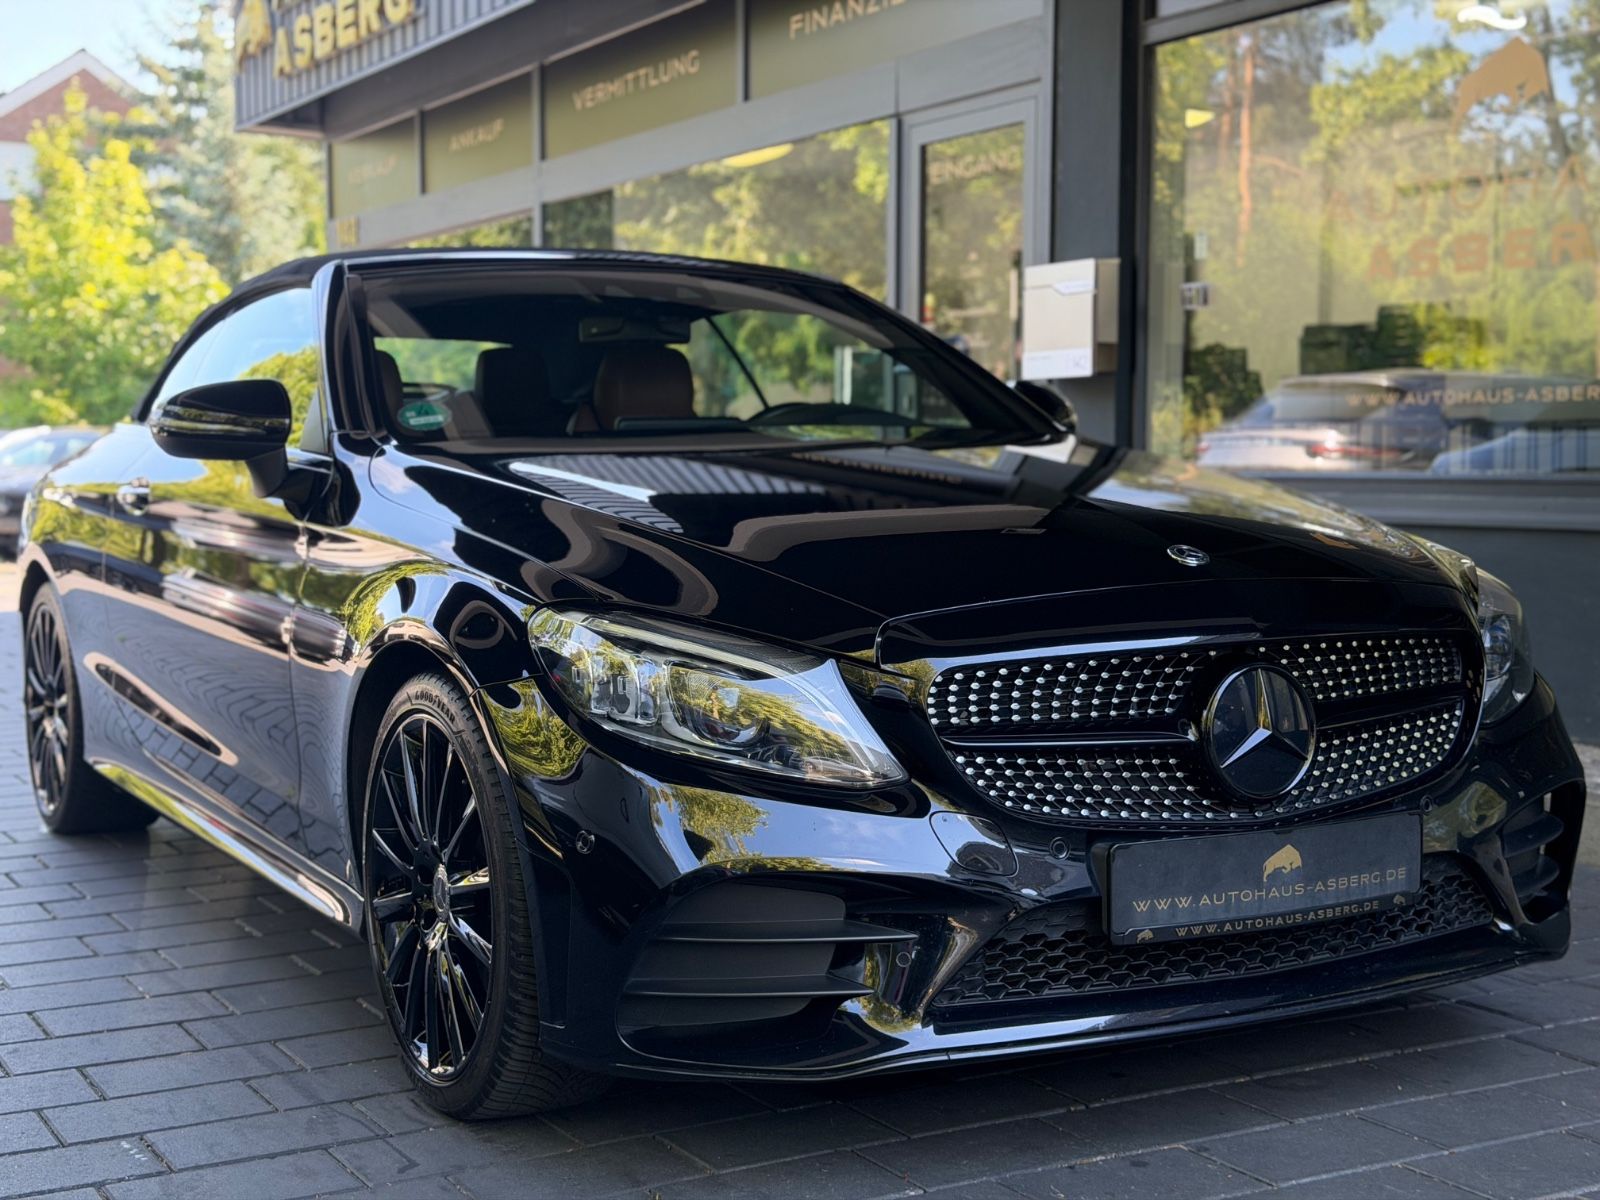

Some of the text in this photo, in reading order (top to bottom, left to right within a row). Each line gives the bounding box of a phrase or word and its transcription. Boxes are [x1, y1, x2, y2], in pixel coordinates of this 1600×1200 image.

[788, 0, 907, 40] FINANZ
[572, 49, 700, 111] VERMITTLUNG
[414, 690, 456, 724] GOODYEAR
[1132, 867, 1407, 913] WWW.AUTOHAUS-ASBERG.DE
[1175, 900, 1380, 937] WWW.AUTOHAUS-ASBERG.DE
